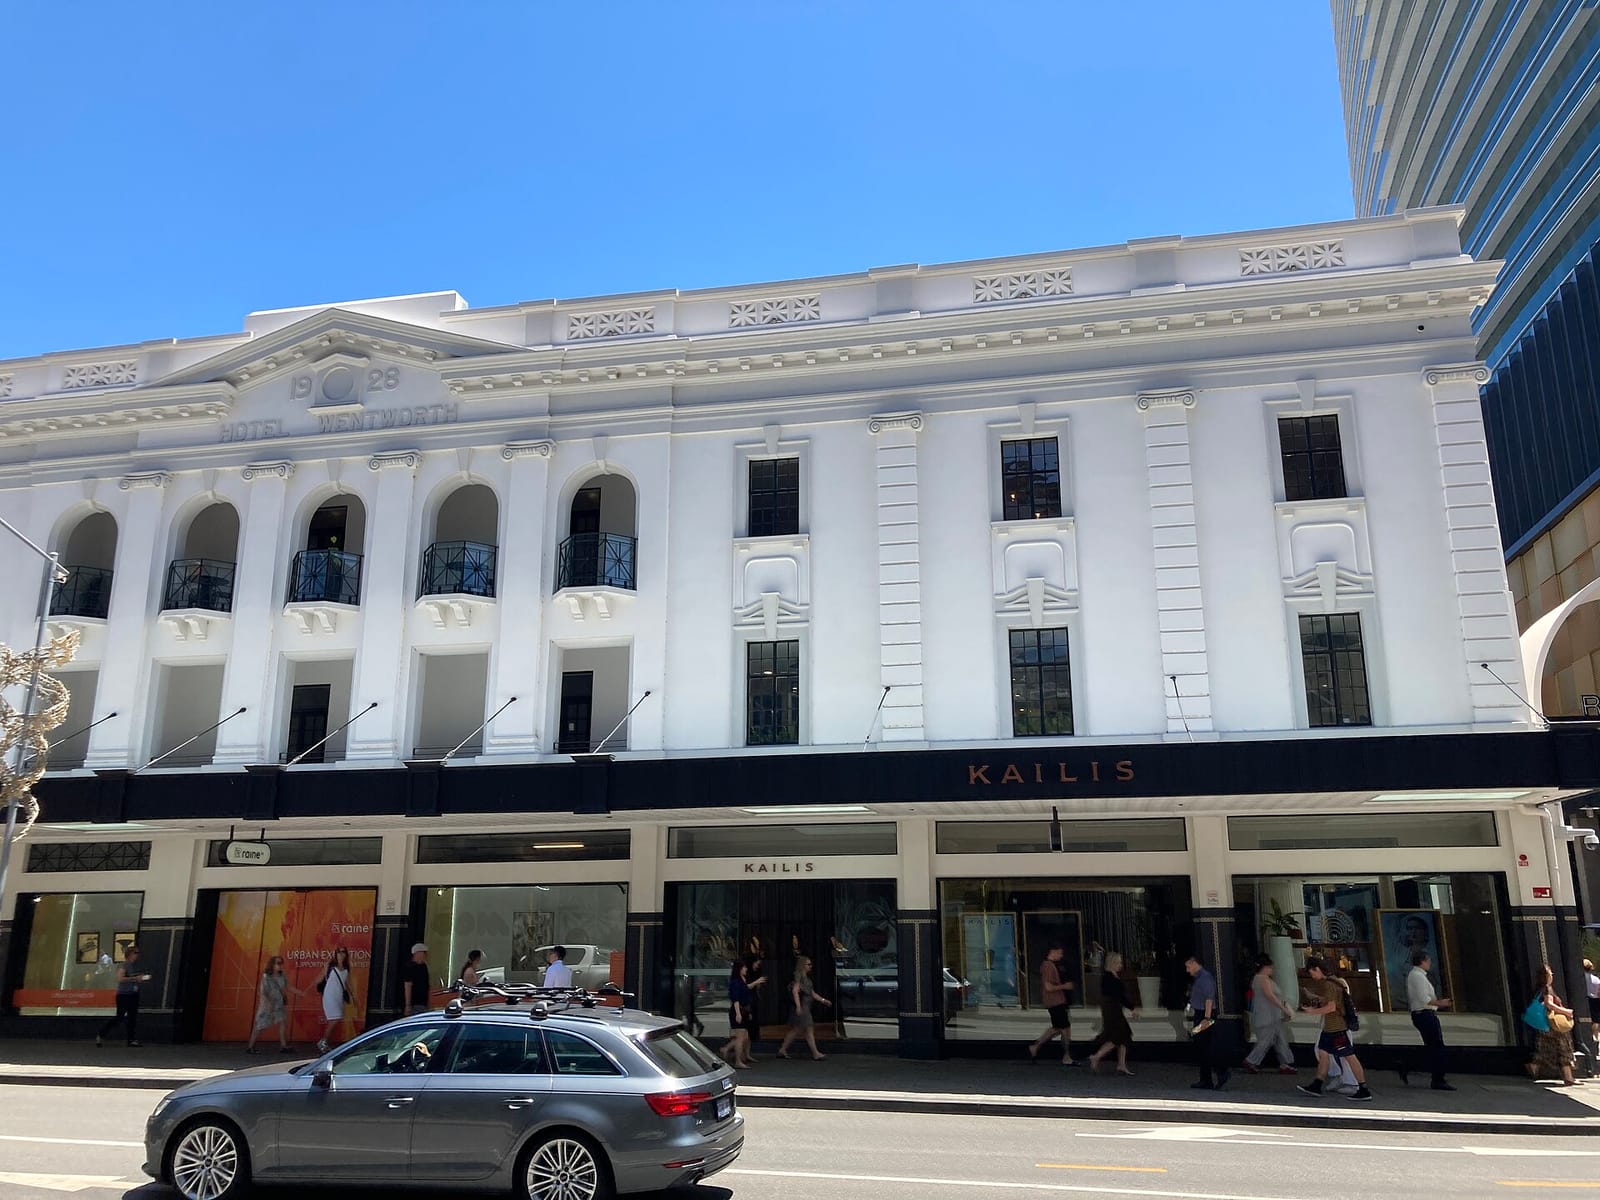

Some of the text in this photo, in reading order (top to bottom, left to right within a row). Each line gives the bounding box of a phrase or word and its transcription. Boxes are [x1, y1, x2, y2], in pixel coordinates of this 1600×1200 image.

[290, 367, 400, 401] 19 28
[220, 403, 459, 443] HOTEL WENTWORTH
[968, 760, 1135, 785] KAILIS
[744, 862, 814, 873] KAILIS
[342, 924, 369, 933] raine
[287, 950, 319, 960] URBAN
